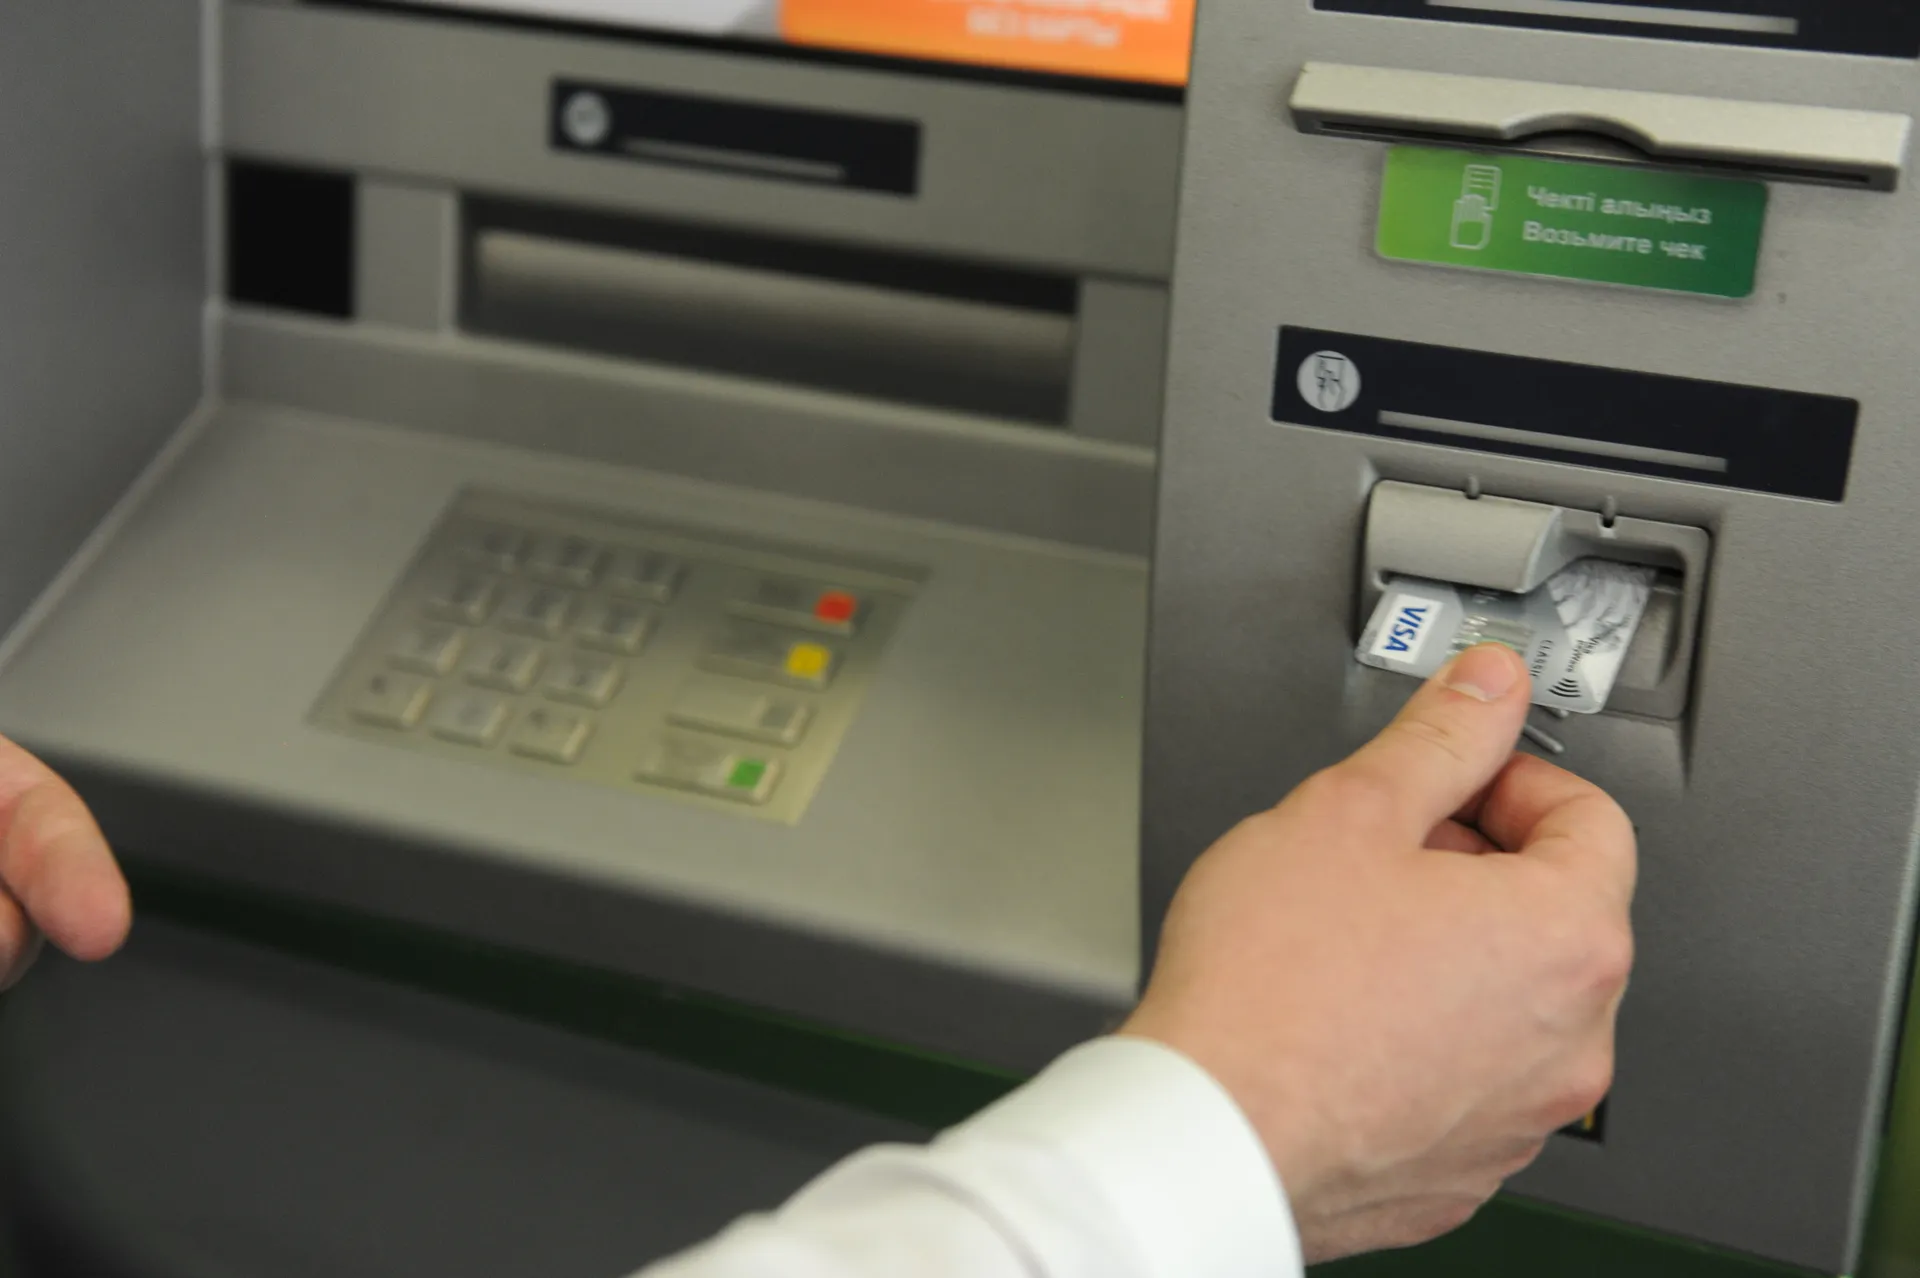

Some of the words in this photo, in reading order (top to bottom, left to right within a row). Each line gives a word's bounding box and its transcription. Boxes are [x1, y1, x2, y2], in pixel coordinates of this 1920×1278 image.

[1527, 185, 1596, 212] Чекті
[1523, 220, 1653, 254] Возьмите
[1660, 240, 1707, 260] чек
[1384, 607, 1427, 651] VISA
